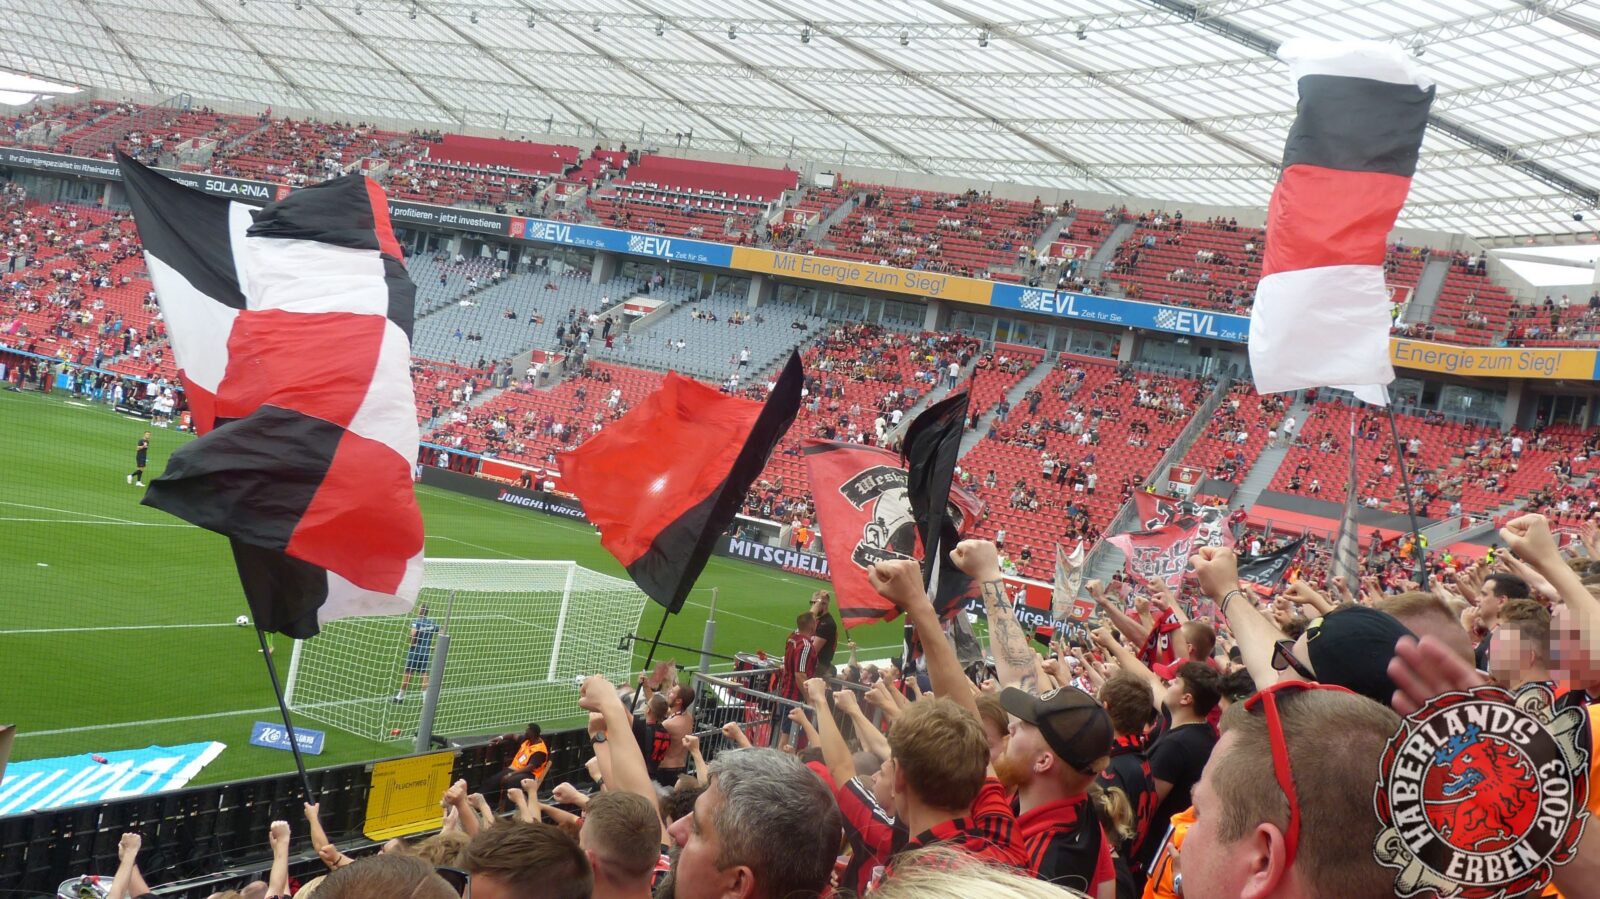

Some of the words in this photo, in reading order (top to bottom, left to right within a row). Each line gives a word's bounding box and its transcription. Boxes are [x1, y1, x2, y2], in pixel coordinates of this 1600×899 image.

[205, 180, 269, 199] SOLARNIA
[394, 207, 433, 220] profitieren
[439, 213, 457, 223] jetzt
[459, 215, 502, 229] investieren
[544, 223, 573, 243] EVL
[643, 236, 674, 258] EVL
[773, 254, 797, 271] Mit
[801, 255, 860, 282] Energie
[864, 270, 899, 286] zum
[904, 272, 947, 295] Sieg!
[1039, 291, 1079, 317] EVL
[1081, 309, 1096, 319] Zeit
[1175, 311, 1218, 337] EVL
[1395, 342, 1475, 371] Energie
[1477, 356, 1513, 370] zum
[1517, 351, 1563, 376] Sieg!
[728, 538, 831, 577] MITSCHELI
